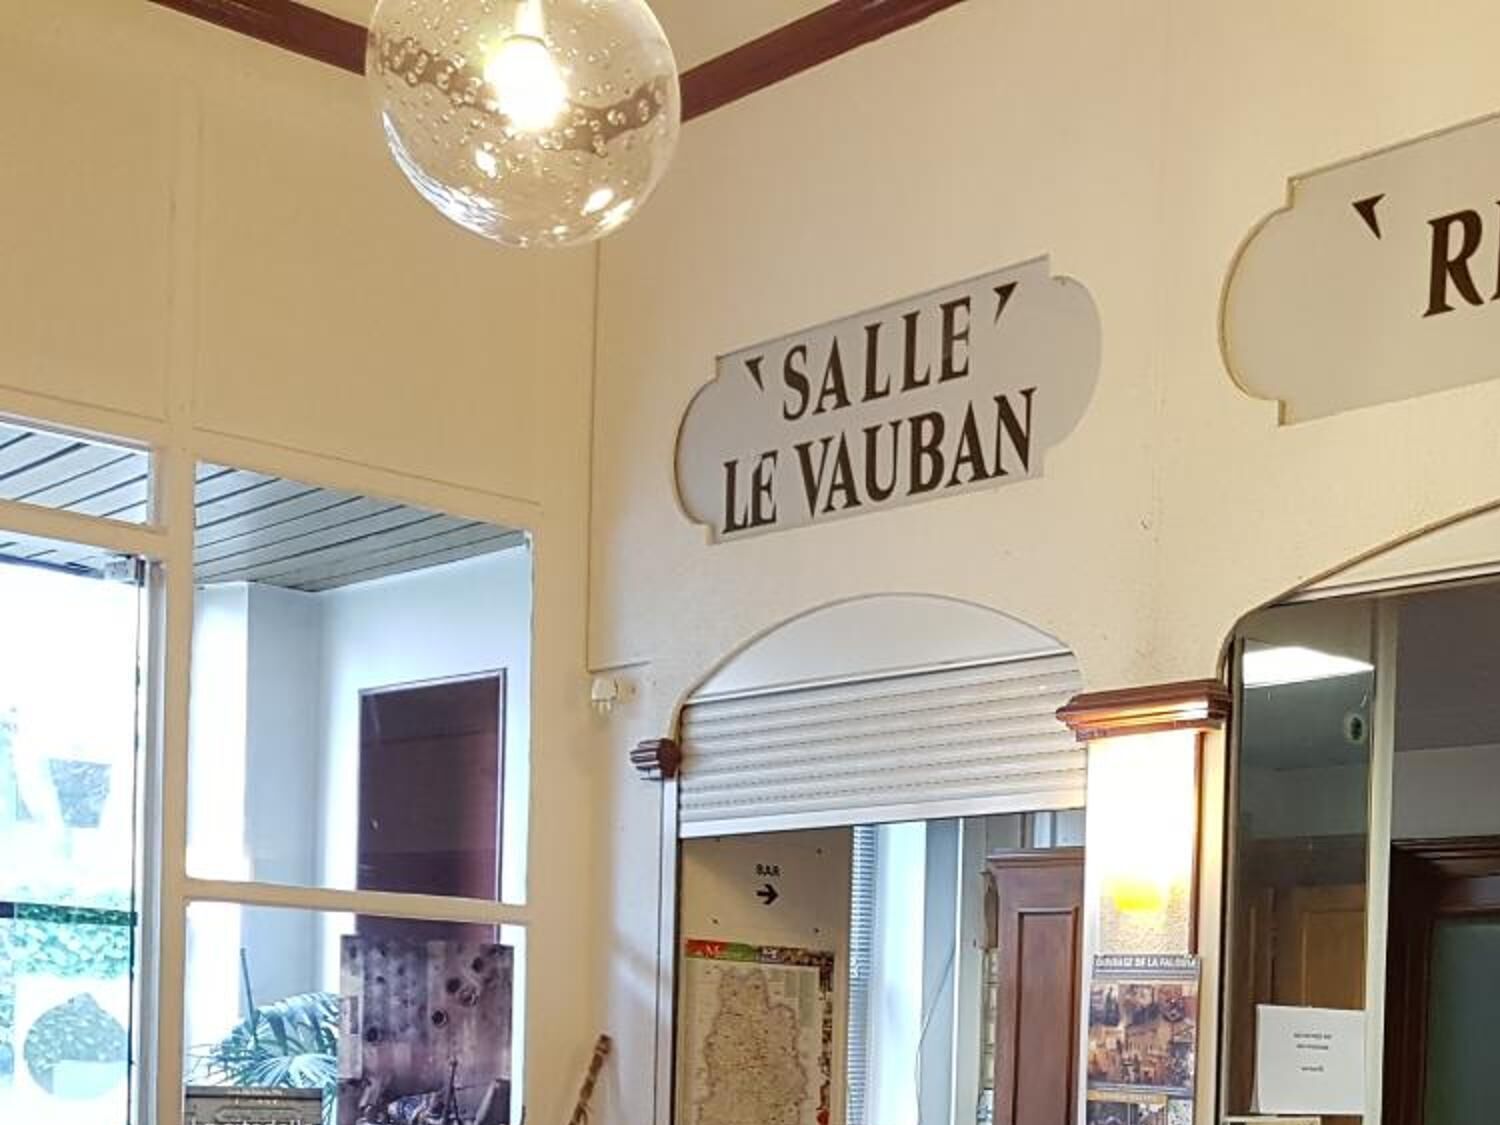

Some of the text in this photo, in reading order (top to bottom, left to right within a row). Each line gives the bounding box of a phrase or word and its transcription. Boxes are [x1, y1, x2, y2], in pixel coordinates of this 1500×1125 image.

[782, 296, 972, 422] SALLE
[722, 387, 1038, 534] LE VAUBAN
